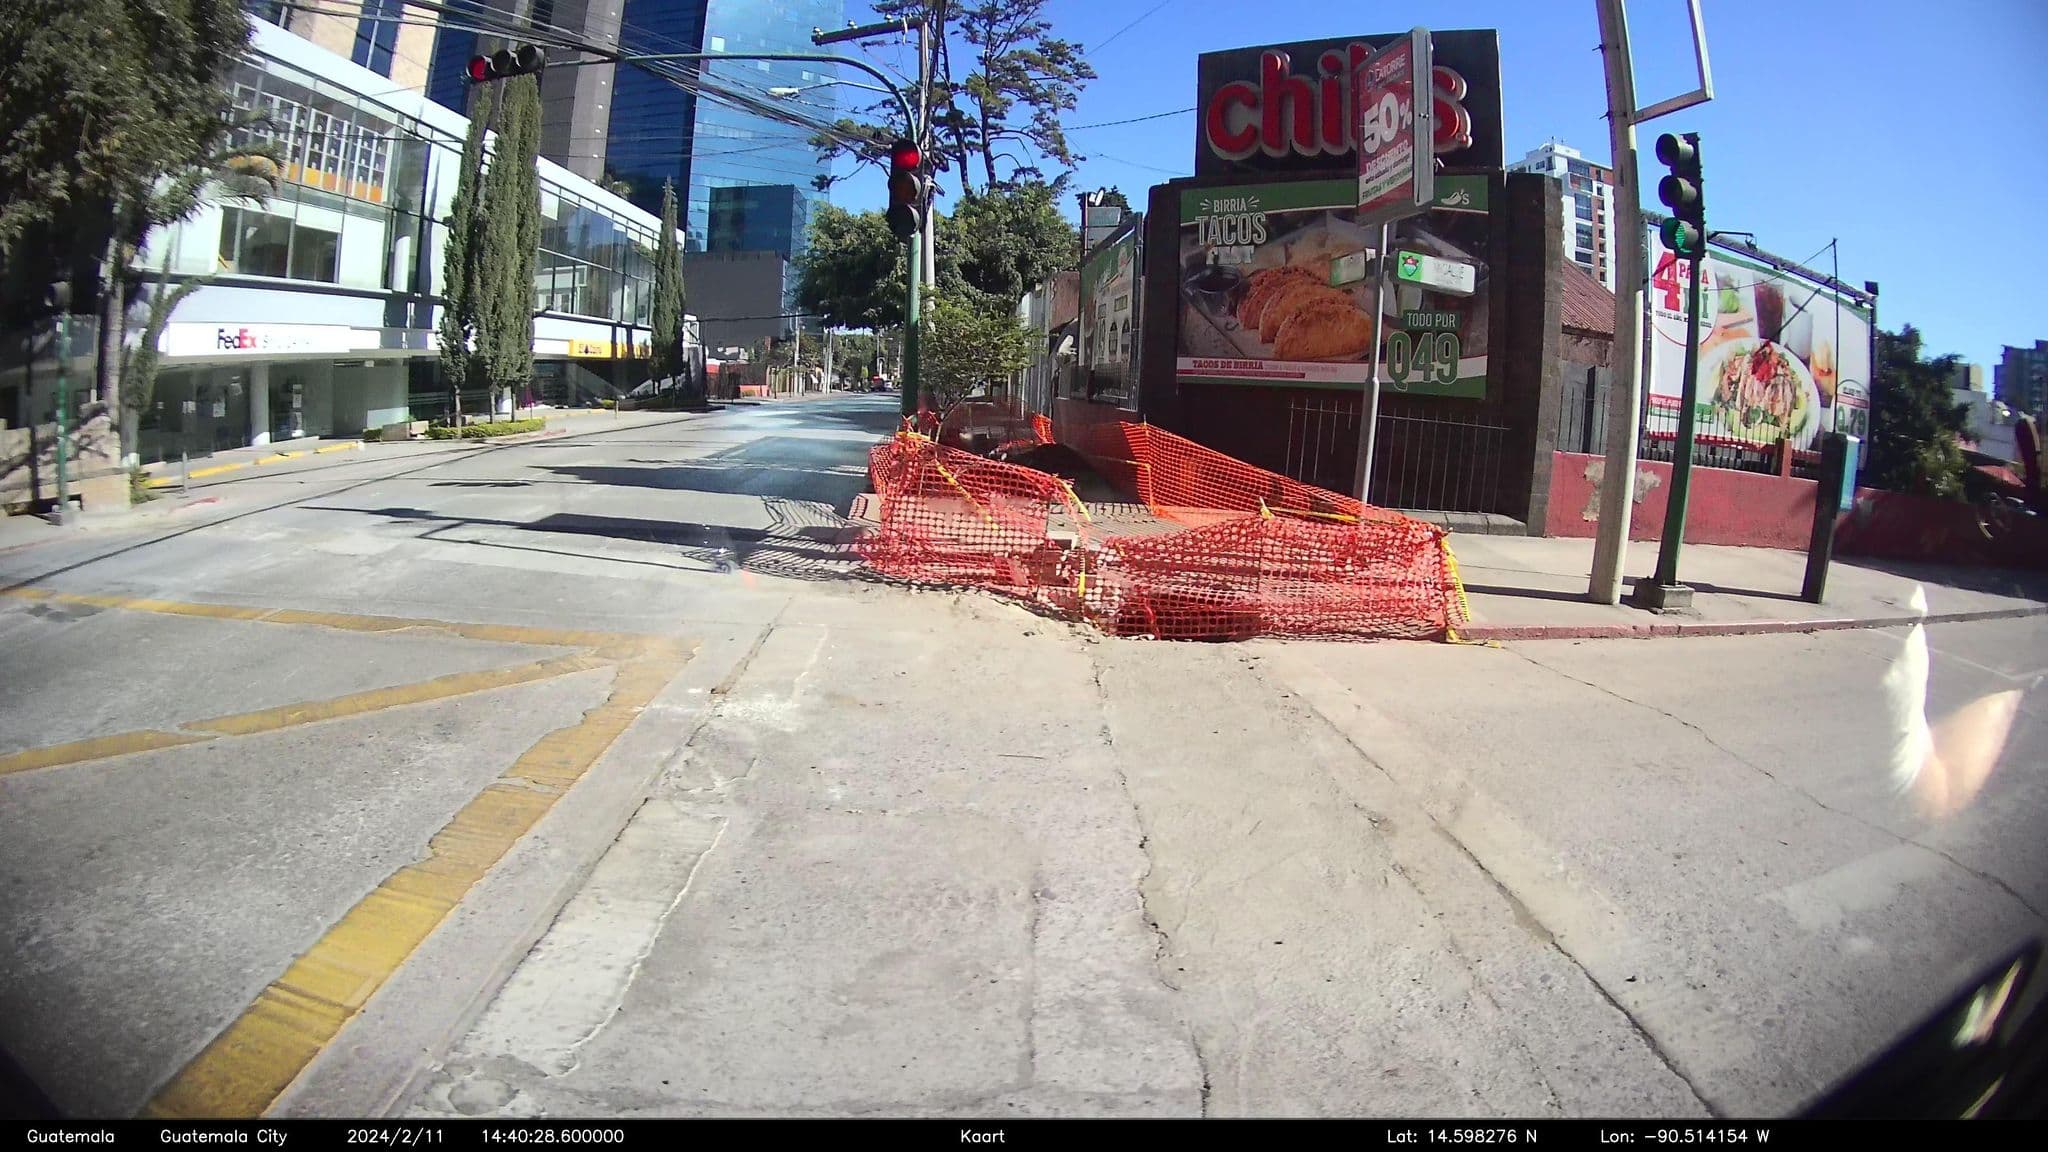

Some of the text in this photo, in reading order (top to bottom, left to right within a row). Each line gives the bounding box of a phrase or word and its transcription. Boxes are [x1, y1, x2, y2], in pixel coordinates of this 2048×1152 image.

[1363, 92, 1412, 154] 50%
[1213, 198, 1247, 213] BIRRIA
[1194, 212, 1267, 246] TACOS
[1653, 252, 1680, 312] 4
[1407, 312, 1456, 328] TODO POR
[217, 327, 257, 350] FedEx
[1192, 360, 1219, 369] TACOS
[1220, 360, 1233, 369] DE
[1387, 331, 1460, 391] Q49
